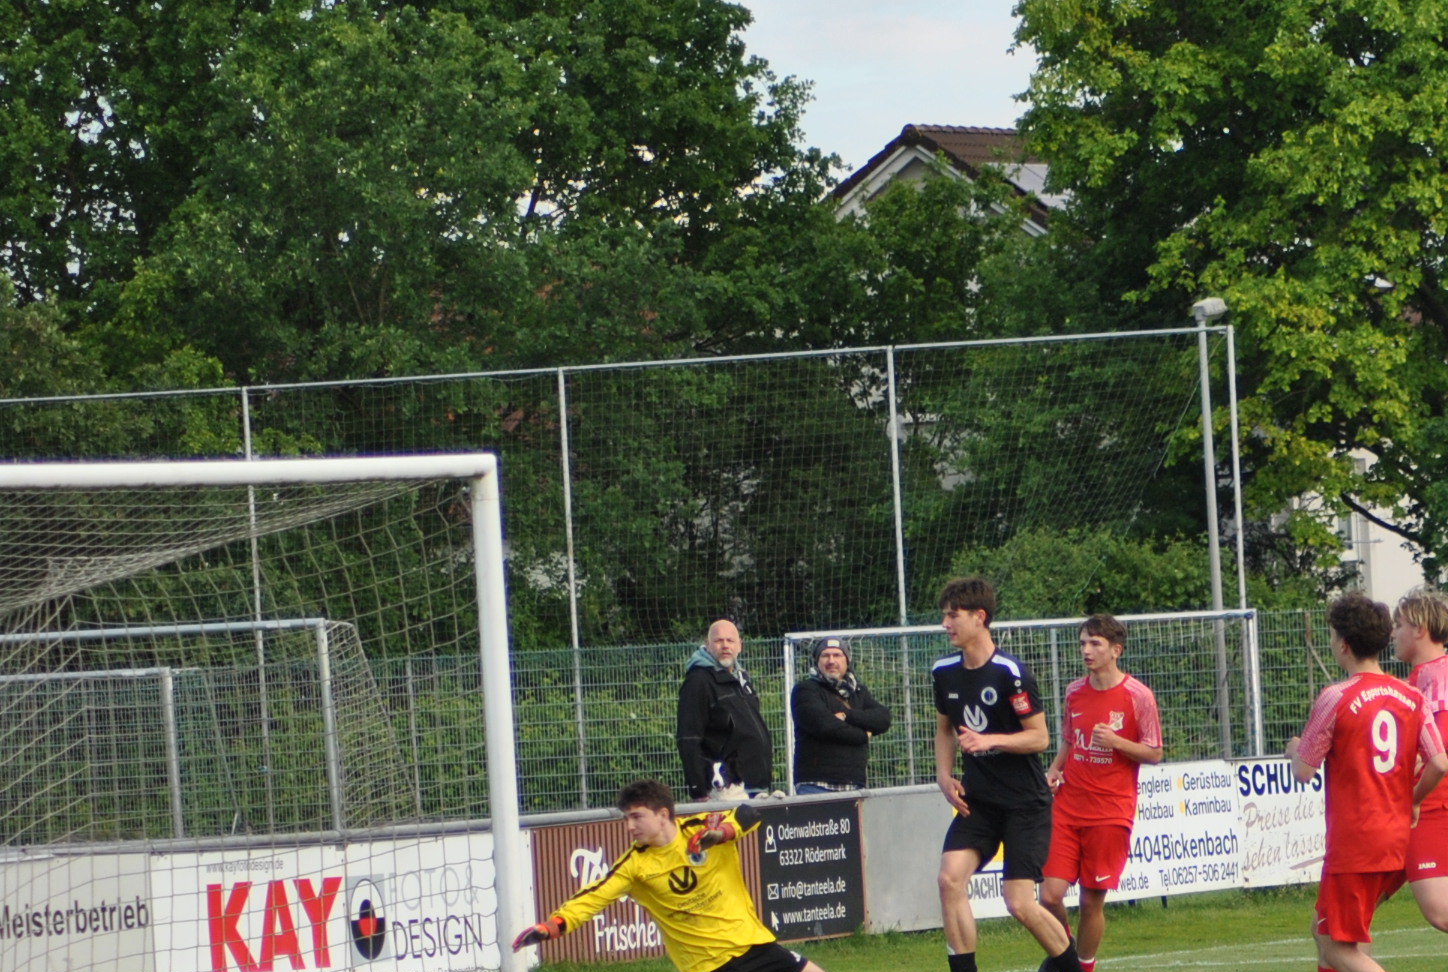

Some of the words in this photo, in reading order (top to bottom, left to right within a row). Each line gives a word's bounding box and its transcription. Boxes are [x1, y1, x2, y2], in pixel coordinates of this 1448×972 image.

[1350, 696, 1362, 714] FV
[1372, 709, 1397, 773] 9
[1182, 771, 1231, 791] Gerüstbau
[1138, 801, 1174, 820] Holzbau
[1184, 796, 1232, 816] Kaminbau
[1243, 801, 1291, 838] Preise
[1294, 793, 1314, 820] die
[778, 819, 839, 841] Odenwaldstraße
[840, 818, 851, 834] 80
[780, 850, 804, 867] 63322
[805, 843, 847, 864] Rödermark
[388, 866, 460, 913] FOTO
[781, 876, 847, 900] info@tanteela.de
[783, 902, 847, 925] www.tanteela.de
[392, 912, 483, 961] DESIGN
